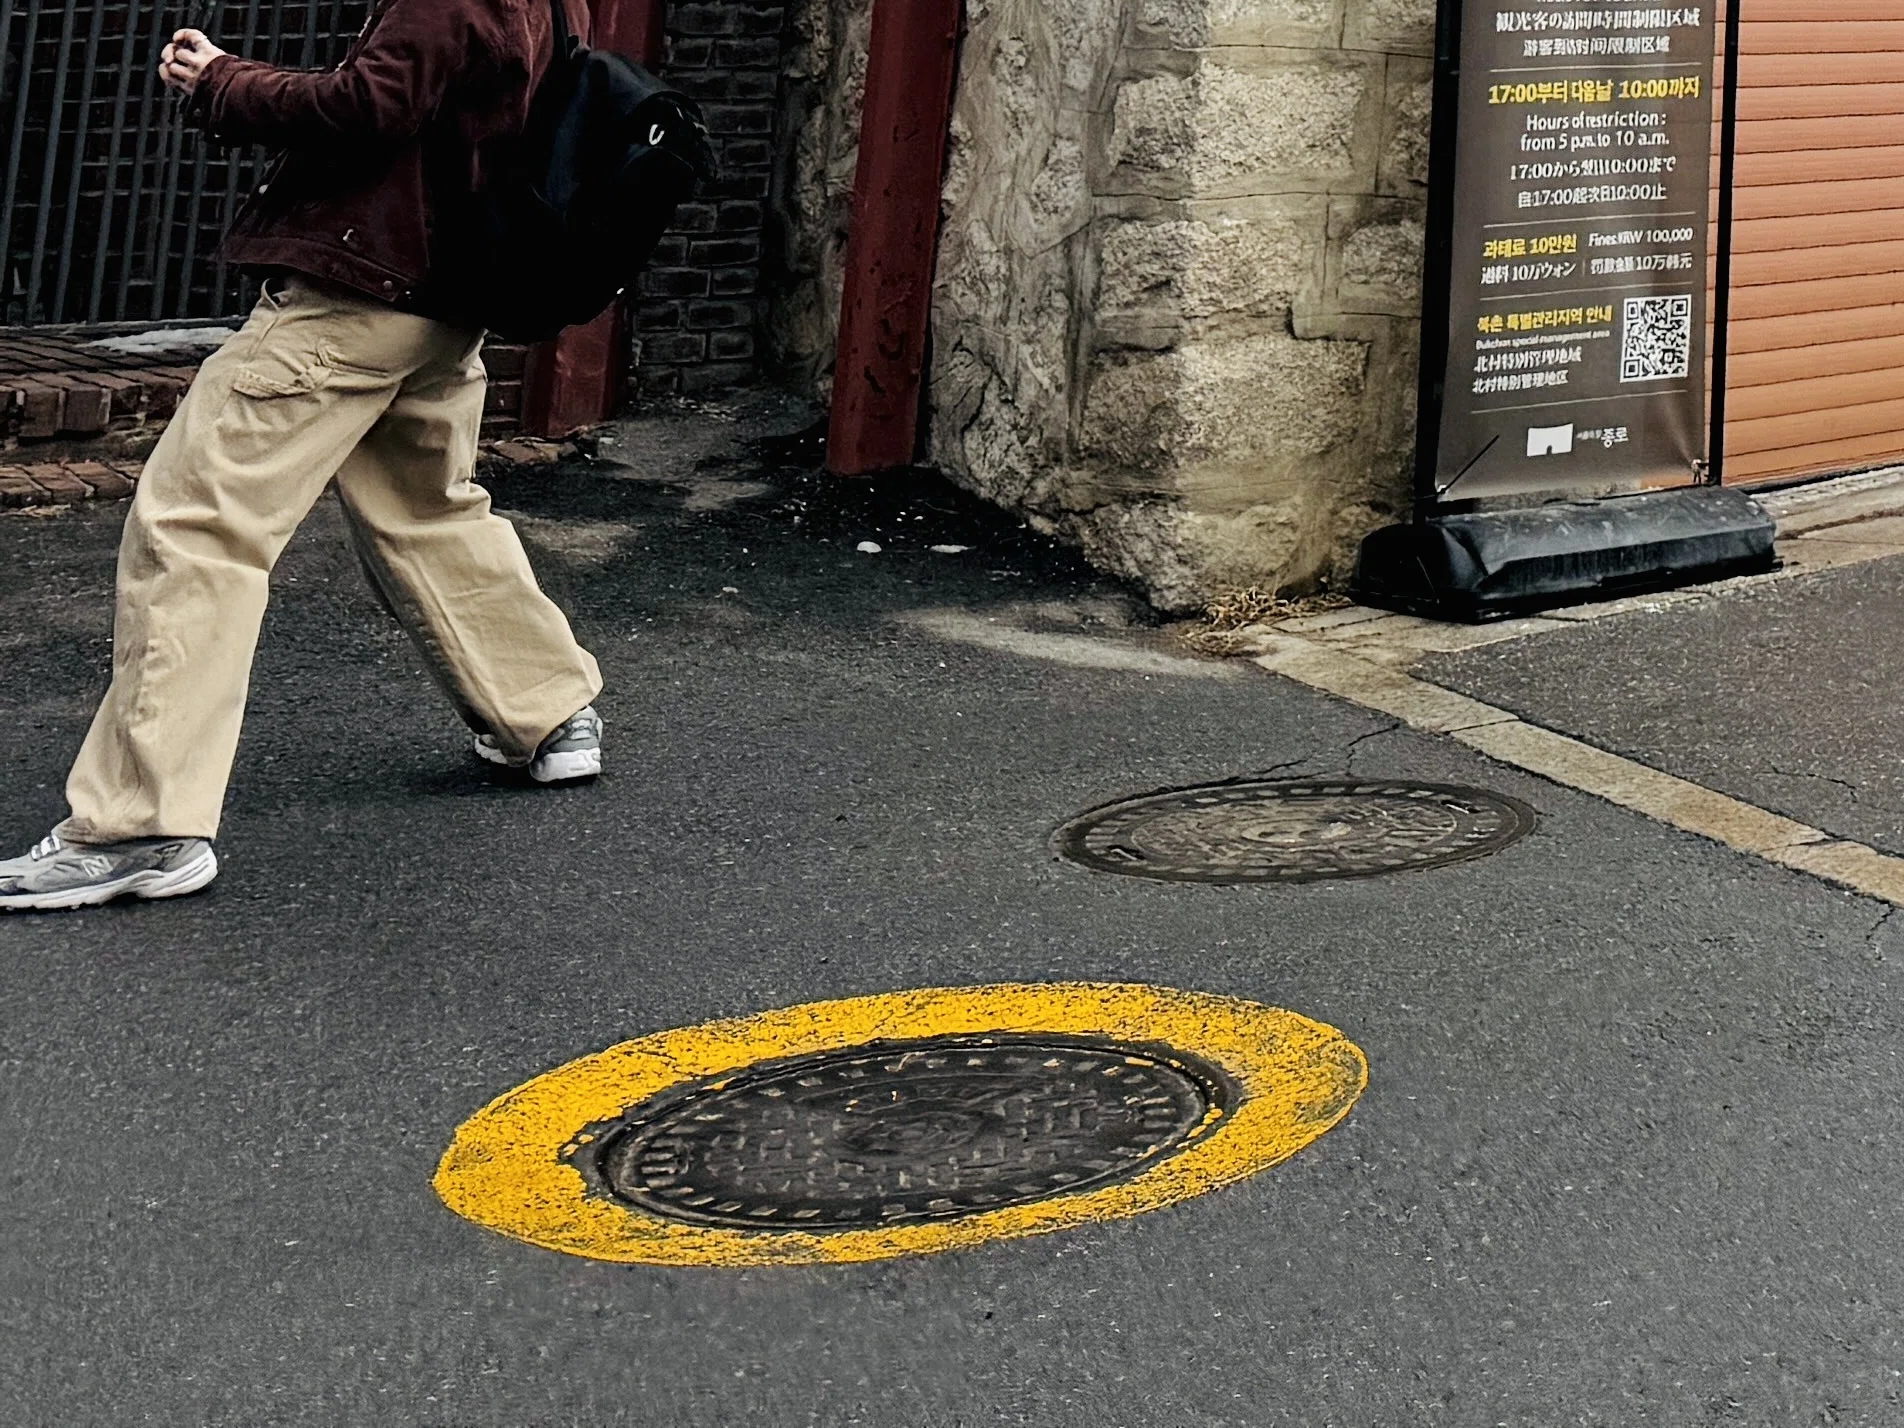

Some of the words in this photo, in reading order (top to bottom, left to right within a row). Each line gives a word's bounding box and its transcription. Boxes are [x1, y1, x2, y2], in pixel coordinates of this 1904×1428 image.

[1488, 80, 1568, 104] 17:00부터
[1572, 79, 1614, 103] 다음날
[1618, 76, 1700, 99] 10:00까지
[1526, 114, 1569, 131] Hours
[1572, 111, 1584, 129] of
[1585, 111, 1659, 128] restriction
[1521, 134, 1555, 152] from
[1559, 134, 1568, 150] 5
[1597, 133, 1610, 147] to
[1616, 131, 1634, 146] 10
[1638, 132, 1670, 145] a.m.
[1529, 233, 1577, 255] 10만원
[1646, 227, 1693, 244] 100,000
[1586, 305, 1612, 323] 안내
